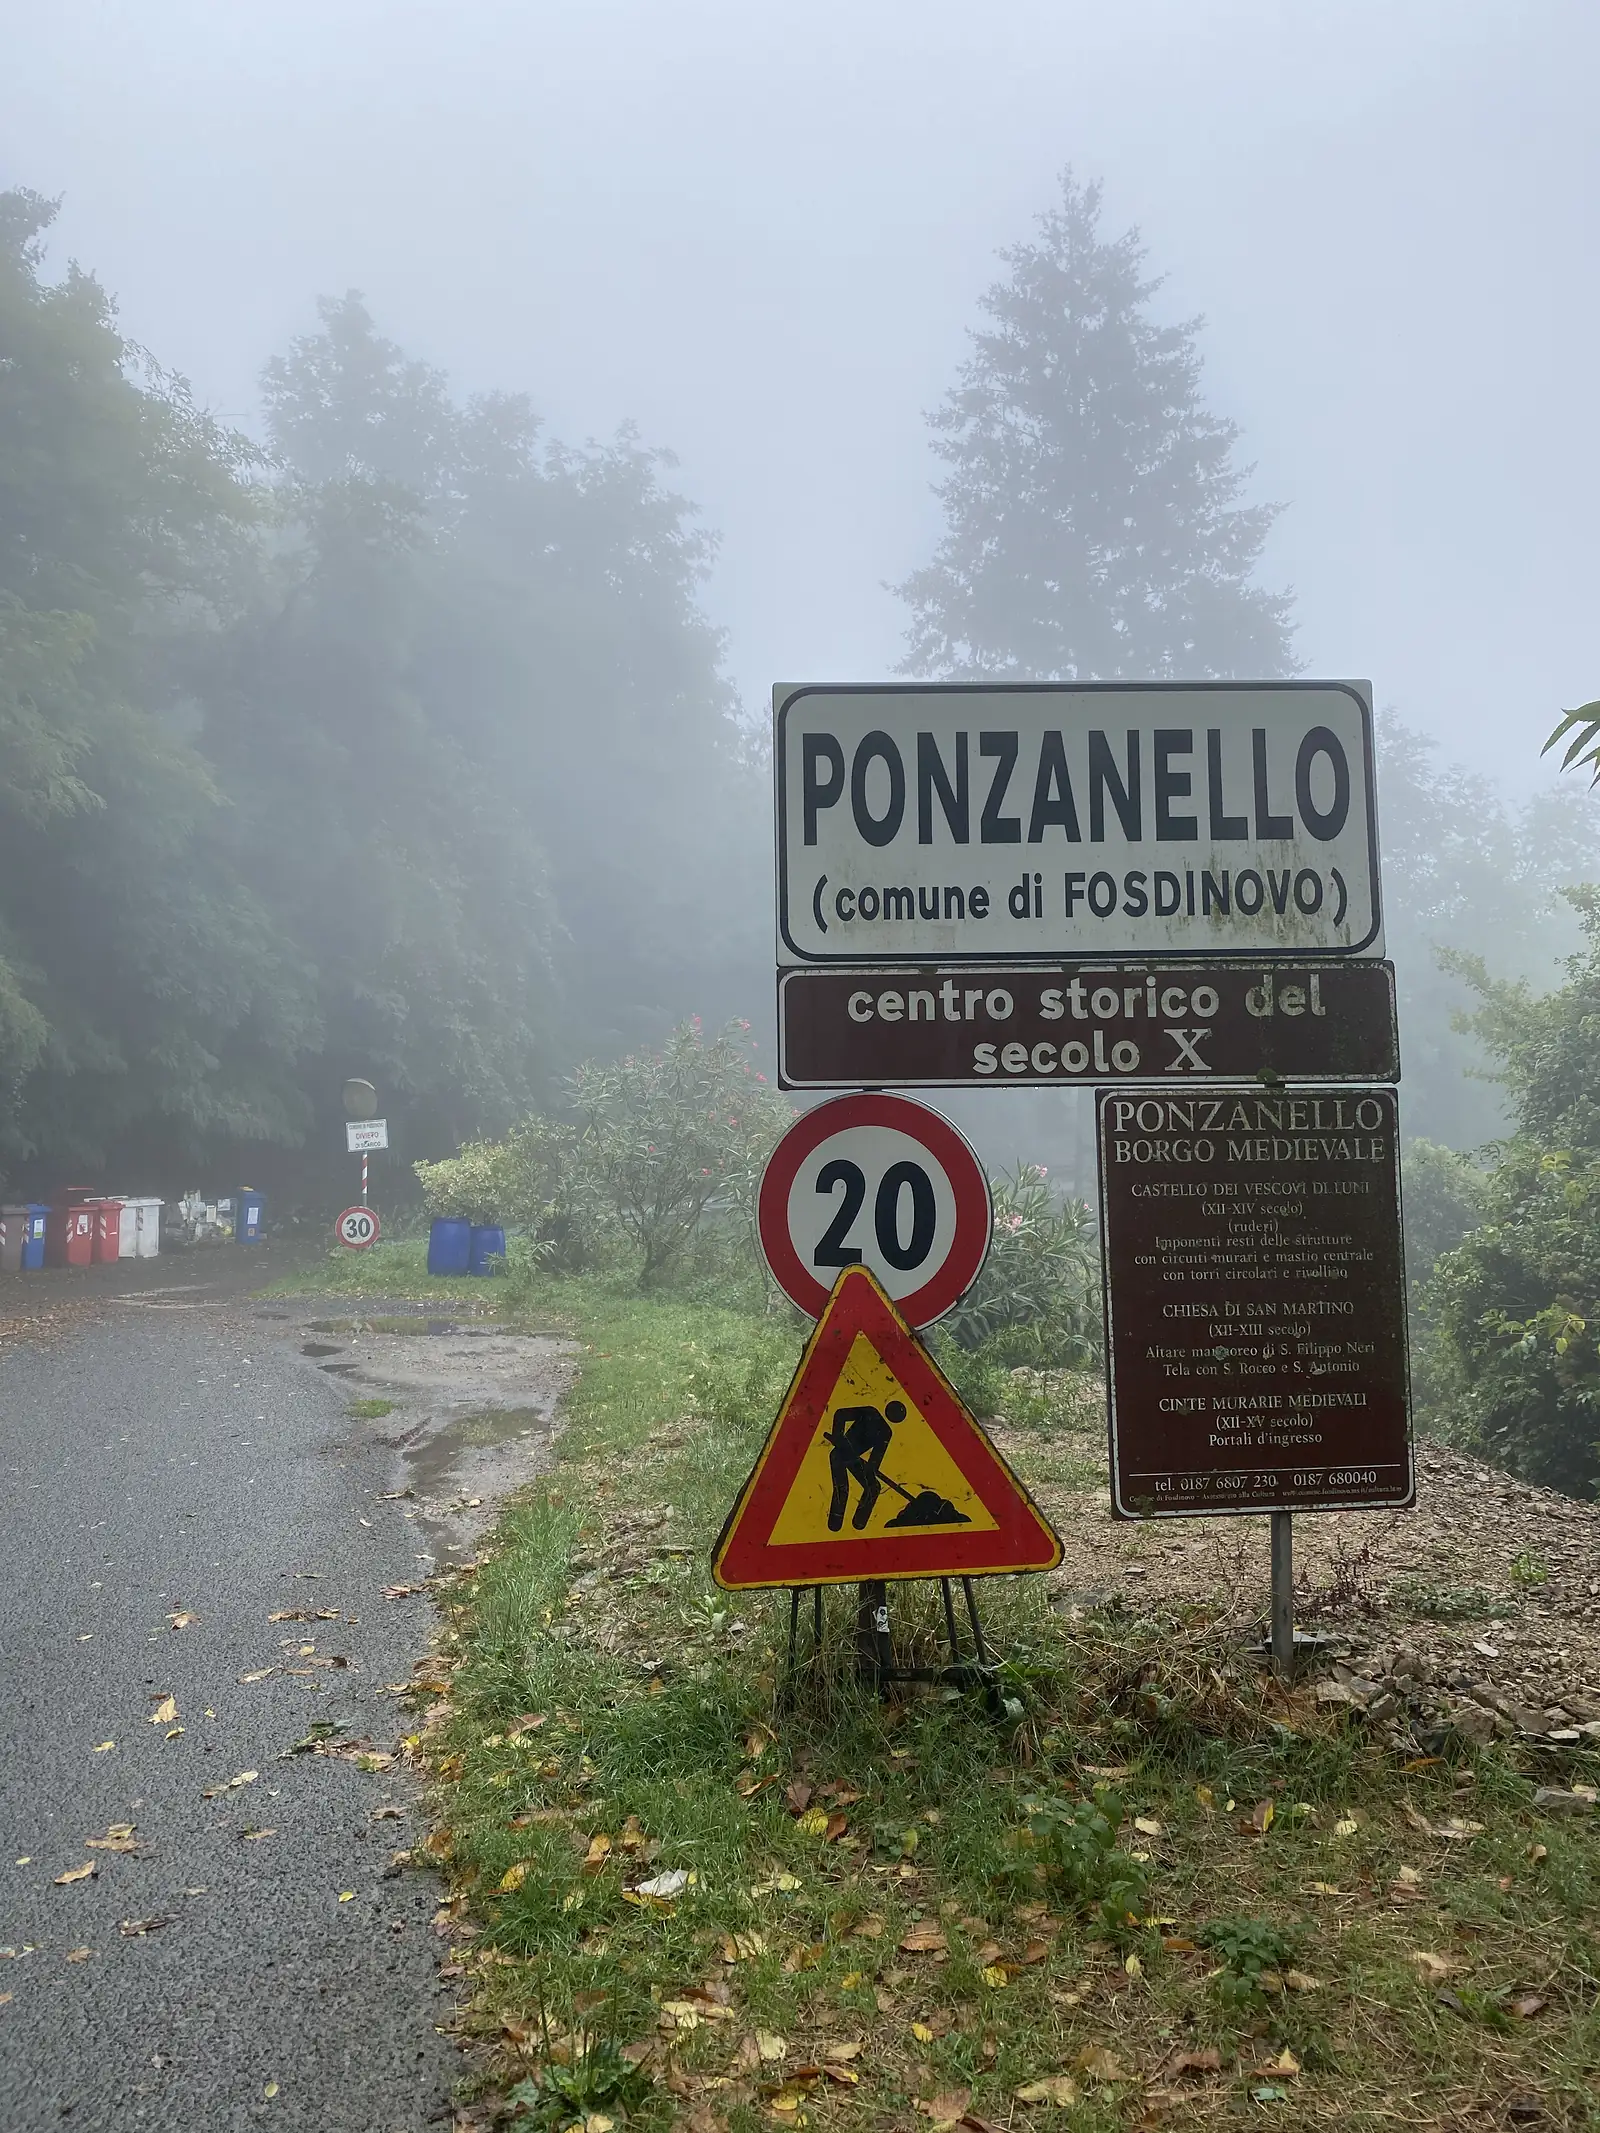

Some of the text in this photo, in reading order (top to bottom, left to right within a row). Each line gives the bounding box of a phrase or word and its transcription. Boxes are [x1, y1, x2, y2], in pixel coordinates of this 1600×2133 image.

[802, 726, 1350, 848] PONZANELLO
[812, 867, 1348, 934] (comune di FOSDINOVO)
[847, 973, 1326, 1022] centro storico del
[972, 1028, 1213, 1075] secolo X
[1113, 1099, 1383, 1132] PONZANELLO
[1114, 1138, 1386, 1163] BORGO MEDIEVALE
[1131, 1183, 1208, 1197] CASTELLO
[1213, 1183, 1239, 1196] DEI
[1244, 1182, 1307, 1196] VESCOVI
[1334, 1181, 1370, 1194] LUNI
[813, 1159, 936, 1271] 20
[1260, 1200, 1303, 1216] secolo)
[346, 1218, 371, 1238] 30
[1228, 1218, 1279, 1234] (ruderi)
[1226, 1235, 1255, 1247] resti
[1260, 1233, 1290, 1246] delle
[1295, 1234, 1353, 1246] strutture
[1134, 1247, 1374, 1265] con circuiti murari e mastio centrale
[1163, 1270, 1185, 1281] con
[1190, 1268, 1220, 1280] torri
[1225, 1266, 1278, 1279] circolari
[1283, 1268, 1290, 1278] e
[1162, 1301, 1354, 1318] CHIESA DI SAN MARTINO
[1208, 1321, 1311, 1338] (XII-XIII secolo)
[1146, 1345, 1186, 1358] Altare
[1262, 1343, 1275, 1356] di
[1280, 1343, 1292, 1355] S.
[1297, 1342, 1342, 1358] Filippo
[1346, 1341, 1375, 1353] Neri
[1162, 1363, 1190, 1376] Tela
[1196, 1365, 1218, 1375] con
[1239, 1362, 1276, 1374] Rocco
[1281, 1364, 1288, 1373] e
[1293, 1361, 1304, 1373] S.
[1309, 1360, 1360, 1373] Antonio
[1159, 1393, 1368, 1412] CINTE MURARIE MEDIEVALI
[1216, 1412, 1313, 1431] (XII-XV secolo)
[1209, 1431, 1323, 1448] Portali d'ingresso
[1155, 1471, 1377, 1491] tel. 0187 6807 230 0187 680040
